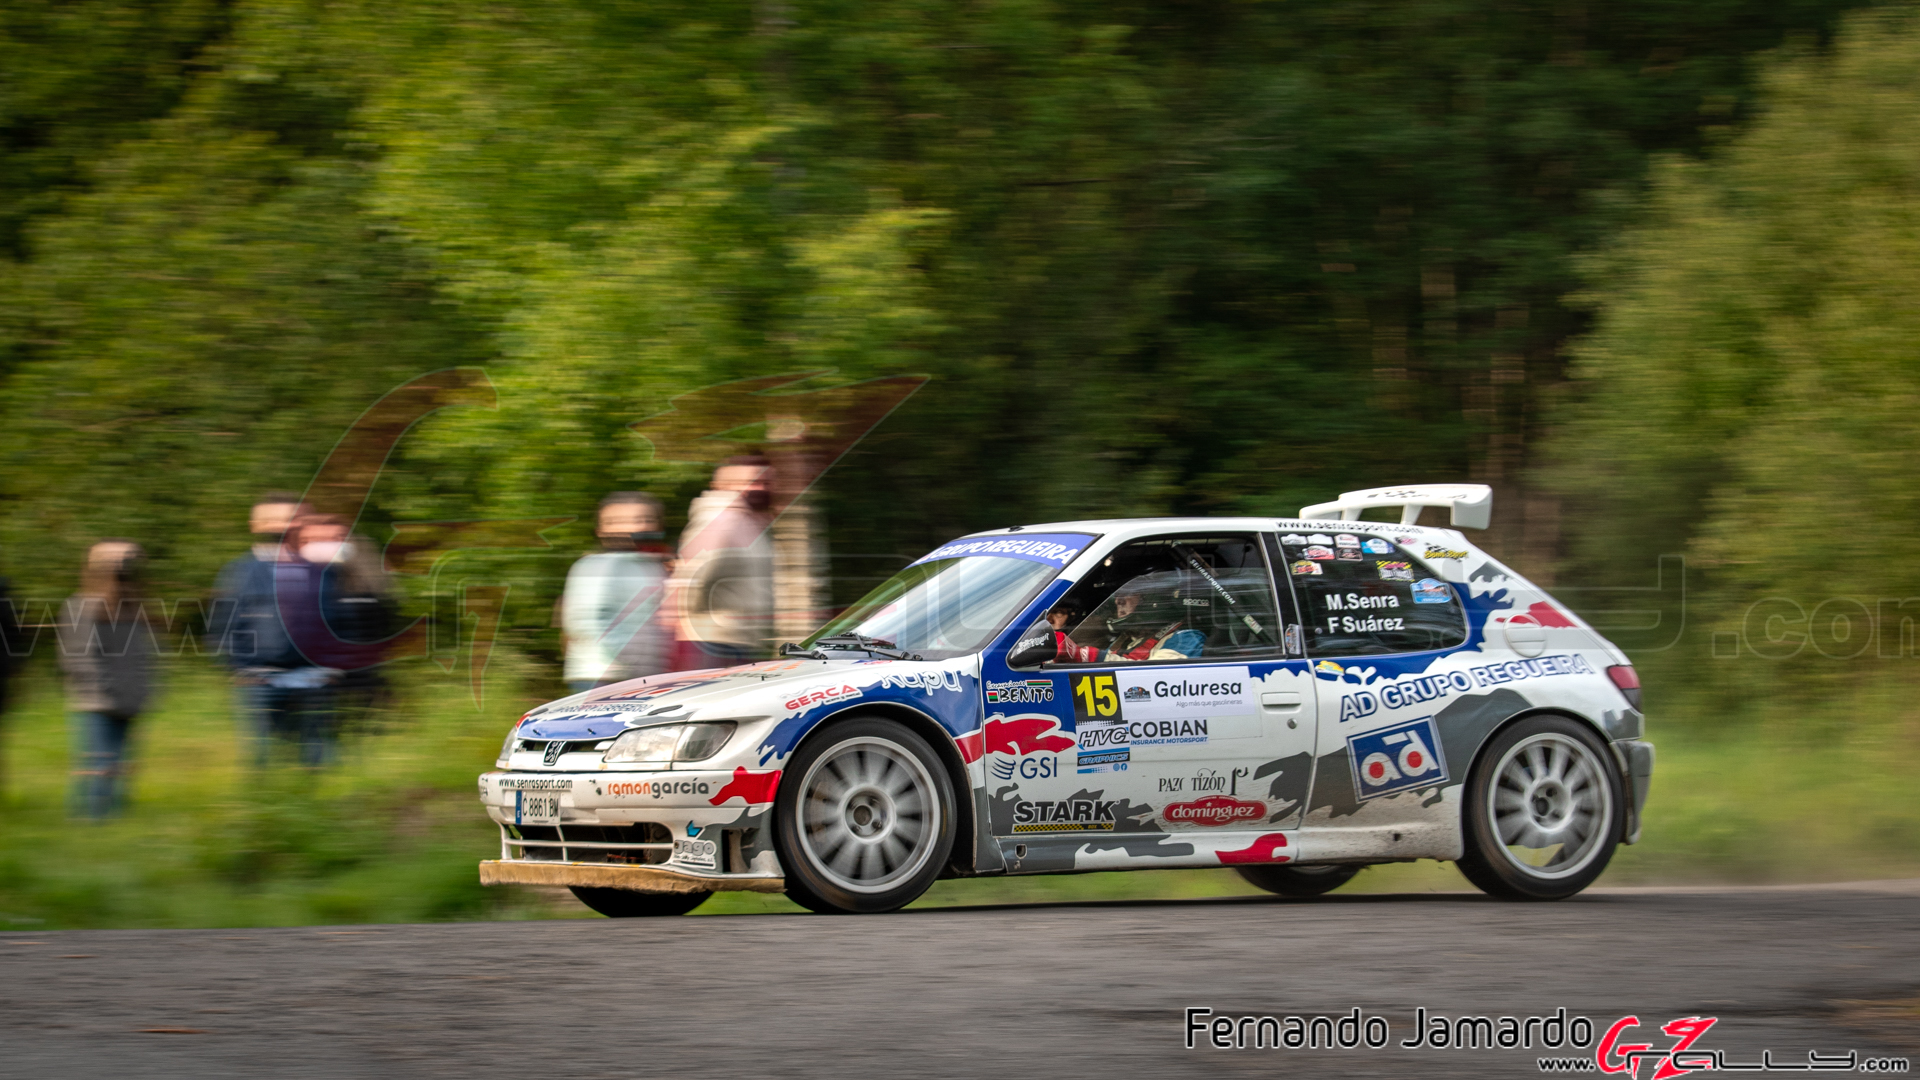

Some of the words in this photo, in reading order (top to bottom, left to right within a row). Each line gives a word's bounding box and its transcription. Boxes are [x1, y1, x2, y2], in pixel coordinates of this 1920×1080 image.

[986, 540, 1079, 564] REGUEIRA
[1325, 592, 1399, 611] M.Senra
[1327, 617, 1340, 634] F
[1342, 615, 1405, 633] Suárez
[785, 684, 858, 710] GERCA
[999, 688, 1054, 703] BENITO
[1076, 675, 1118, 717] 15
[1154, 680, 1242, 698] Galuresa
[1340, 691, 1378, 722] AD
[1380, 670, 1472, 709] GRUPO
[1469, 653, 1595, 688] REGUEIRA
[1212, 699, 1243, 707] gasolineras
[1129, 719, 1208, 738] COBIAN
[1130, 737, 1165, 745] INSURANCE
[1020, 757, 1057, 779] GSI
[1079, 753, 1128, 765] GRAPHICS
[499, 778, 573, 790] www.senrasport.com
[522, 798, 528, 817] C
[529, 797, 548, 818] 8861
[1014, 800, 1117, 824] STARK
